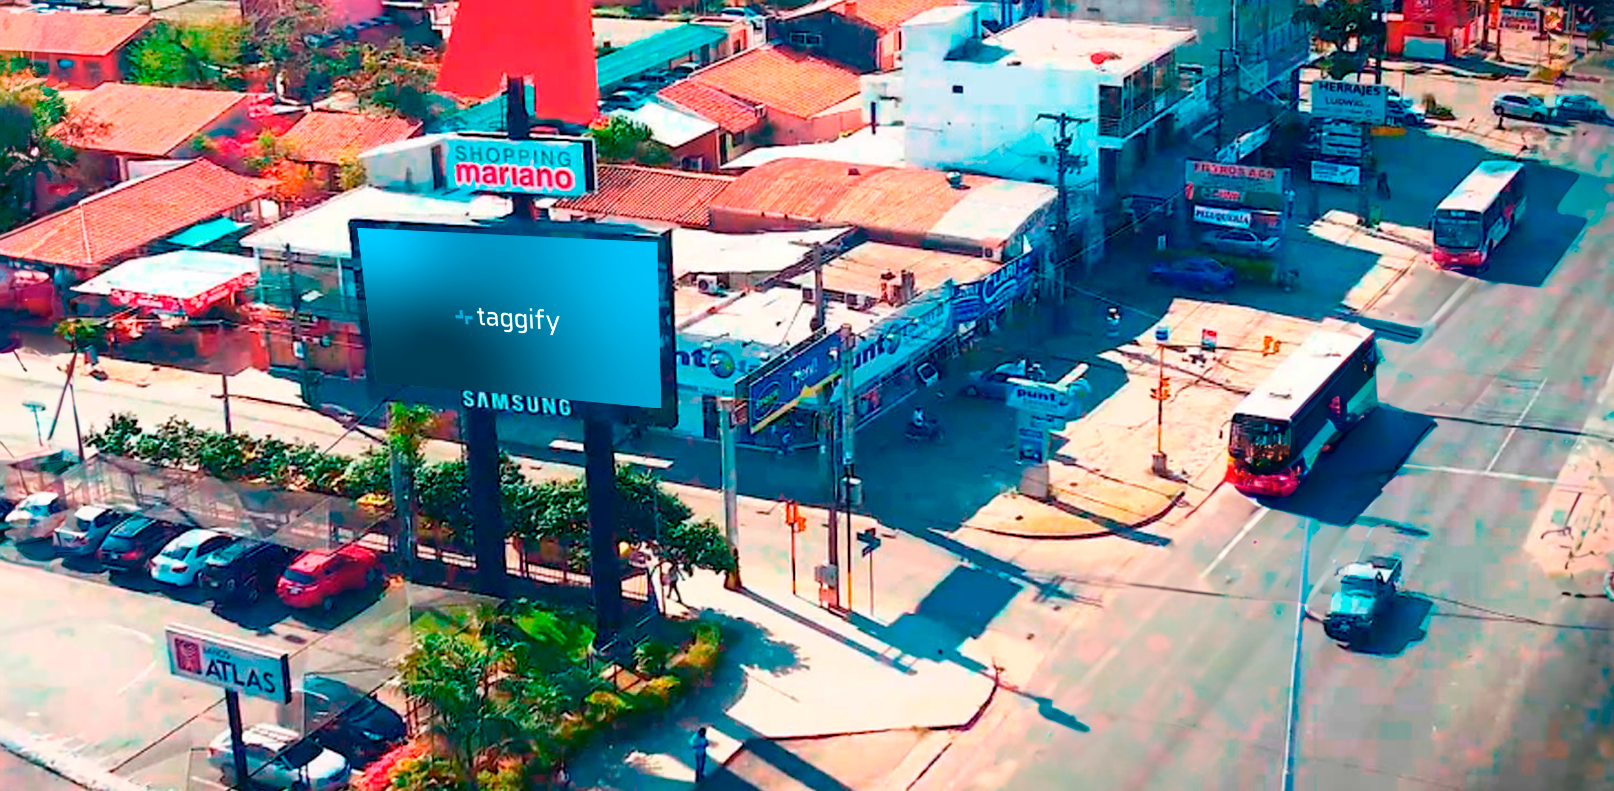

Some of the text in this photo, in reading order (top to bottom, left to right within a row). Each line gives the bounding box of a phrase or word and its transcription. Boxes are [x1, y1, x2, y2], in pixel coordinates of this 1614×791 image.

[1318, 80, 1381, 97] HERRAJES
[455, 145, 572, 167] SHOPPING
[454, 162, 575, 191] mariano
[476, 307, 560, 336] taggify
[462, 390, 572, 416] SAMSUNG
[205, 658, 276, 694] ATLAS
